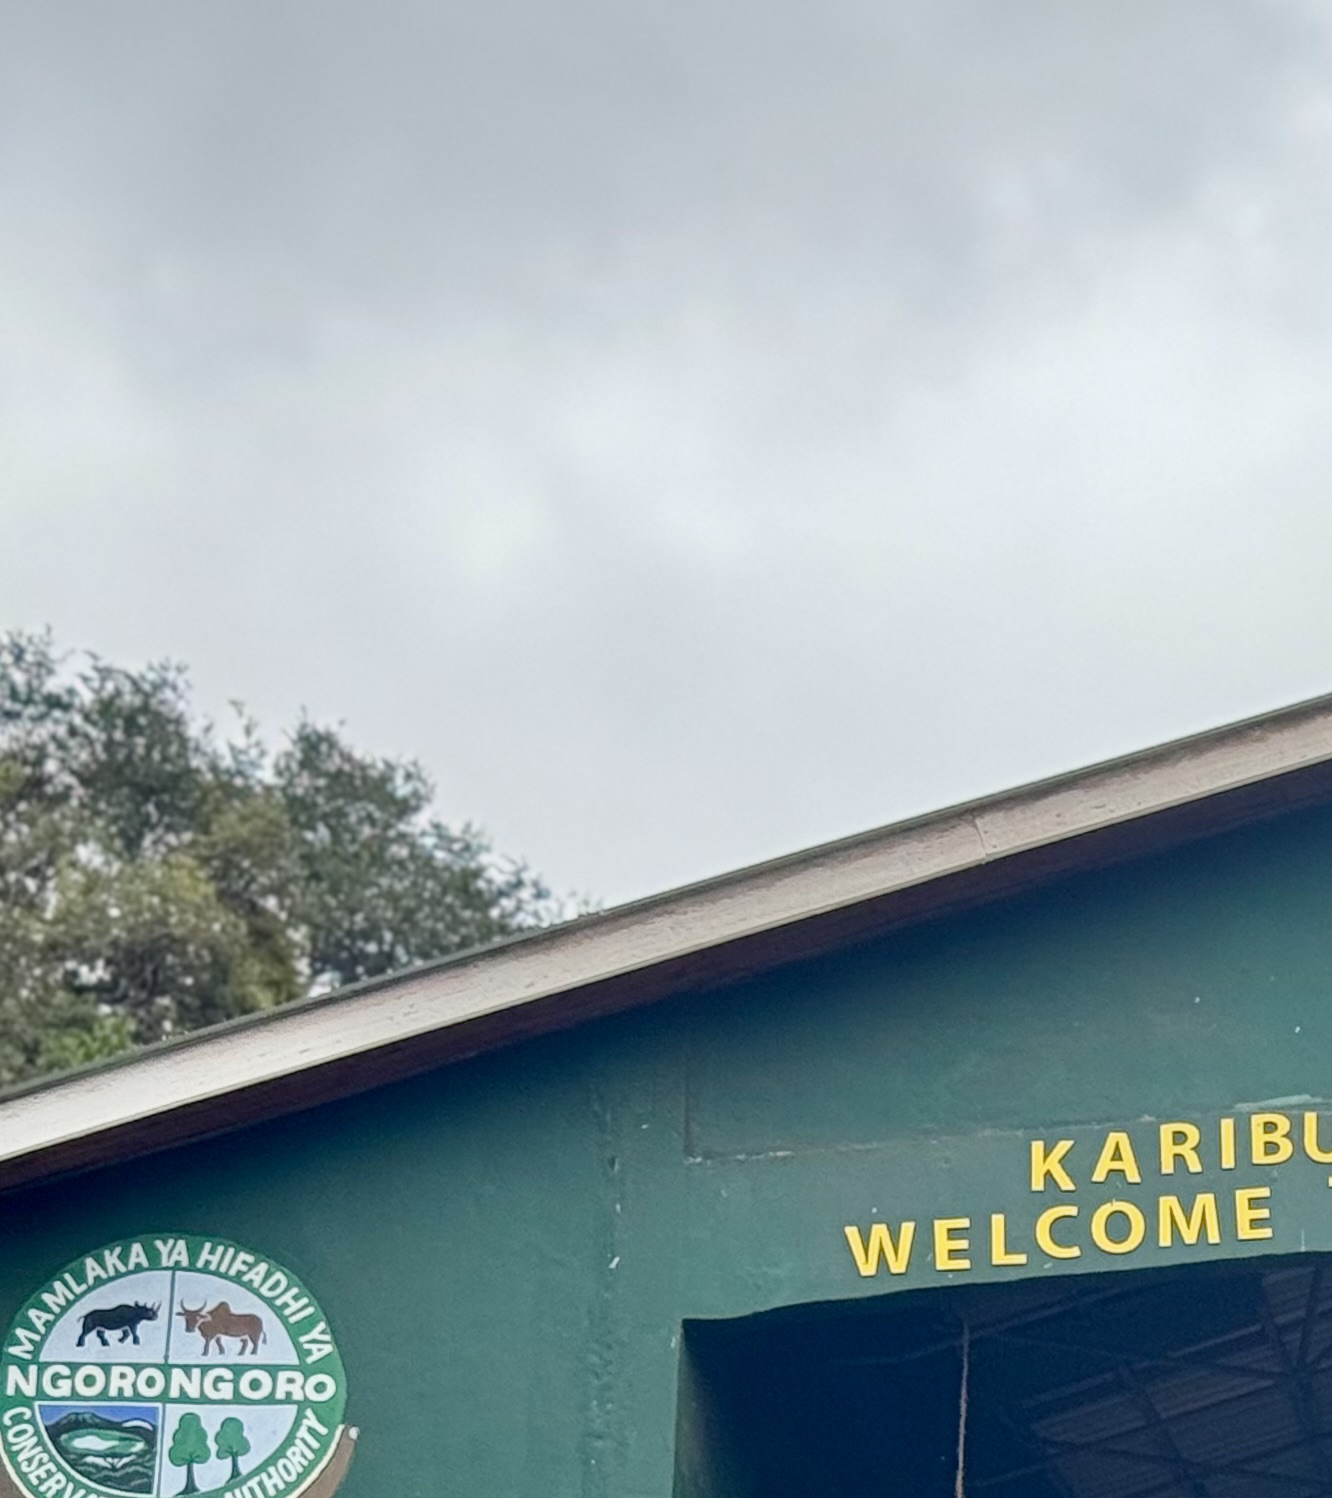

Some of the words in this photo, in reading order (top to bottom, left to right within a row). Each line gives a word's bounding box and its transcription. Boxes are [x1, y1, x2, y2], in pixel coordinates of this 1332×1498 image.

[843, 1186, 1275, 1278] WELCOME
[7, 1241, 149, 1361] MAMLAKA
[153, 1238, 191, 1269] YA
[195, 1241, 315, 1324] HIFADHI
[298, 1320, 334, 1364] YA
[6, 1363, 337, 1403] NGORONGORO
